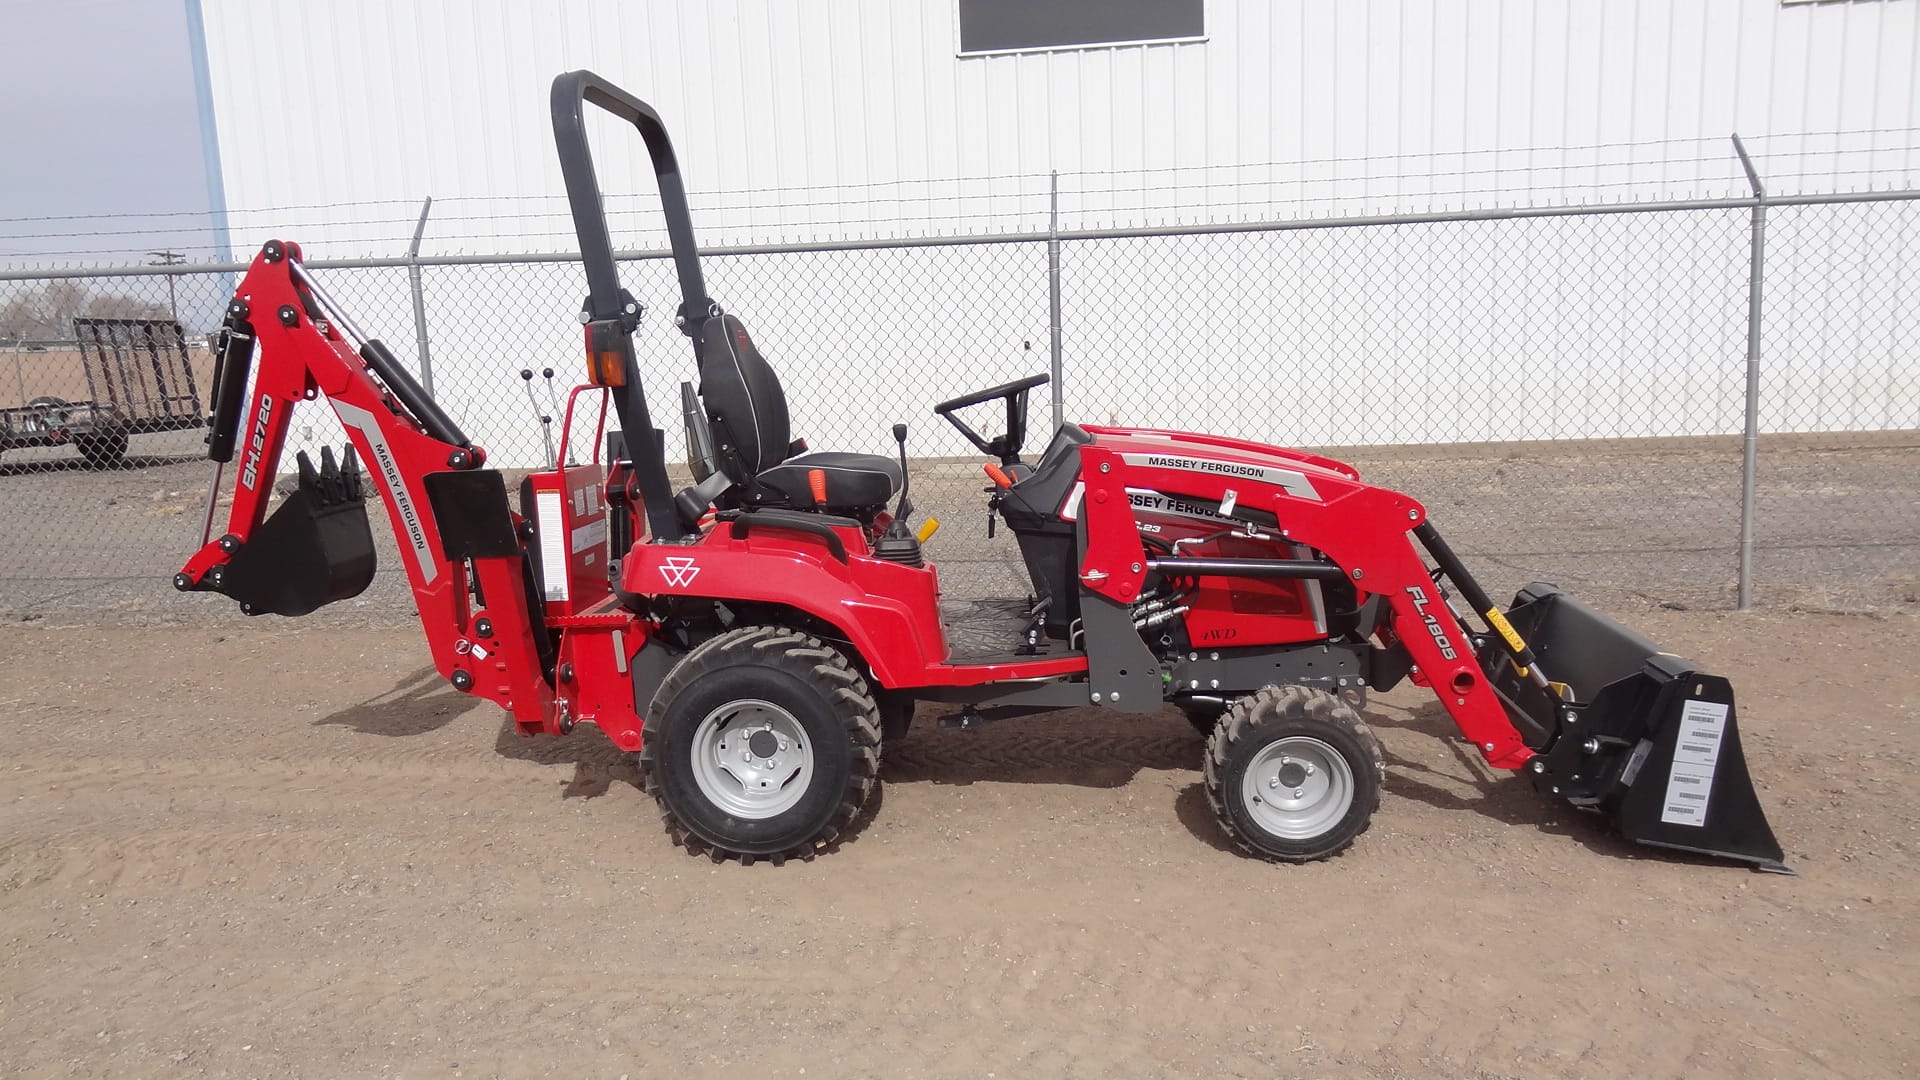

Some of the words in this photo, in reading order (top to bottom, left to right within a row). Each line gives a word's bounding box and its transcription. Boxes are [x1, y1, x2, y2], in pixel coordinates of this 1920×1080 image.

[242, 394, 273, 492] BH.2720
[1148, 457, 1198, 470] MASSEY
[1200, 462, 1265, 478] FERGUSON
[375, 443, 401, 488] MASSEY
[396, 491, 425, 550] FERGUSON
[1127, 493, 1163, 509] SSEY
[1405, 586, 1458, 660] FL.1805
